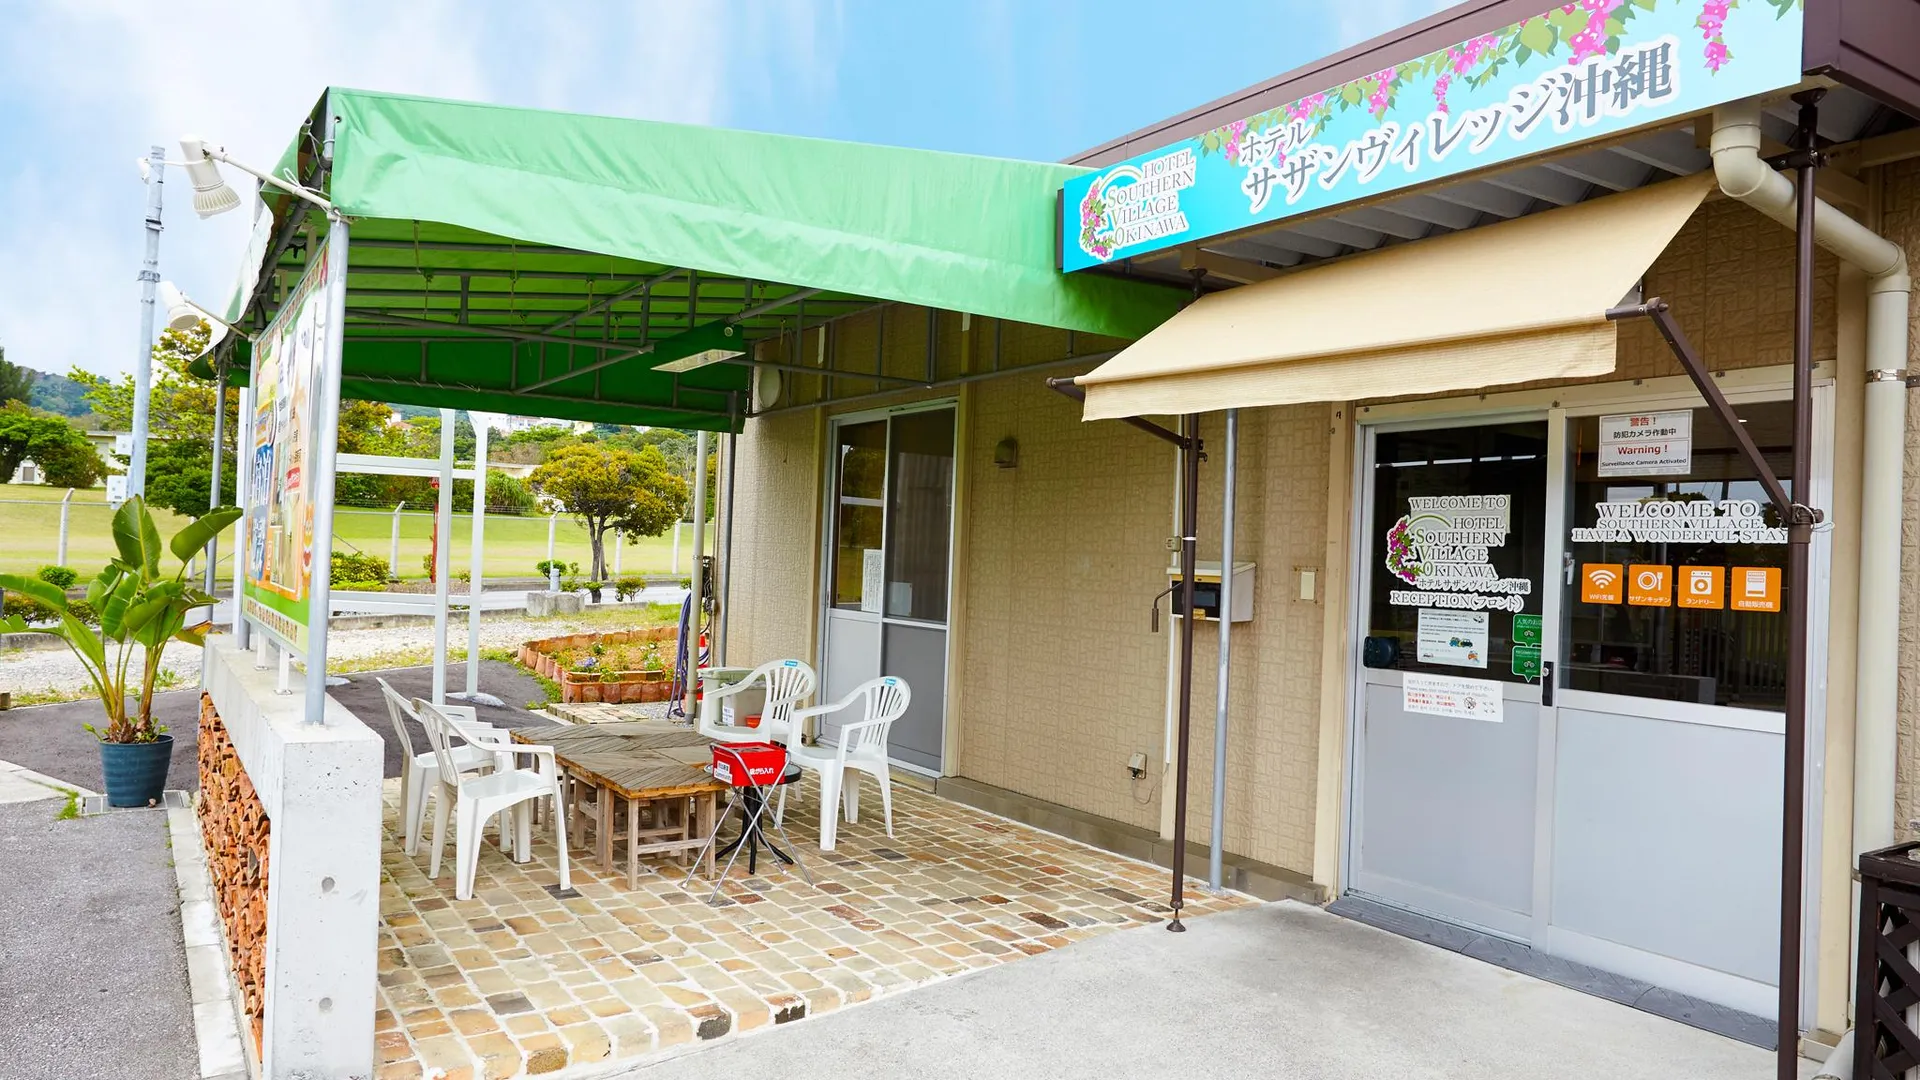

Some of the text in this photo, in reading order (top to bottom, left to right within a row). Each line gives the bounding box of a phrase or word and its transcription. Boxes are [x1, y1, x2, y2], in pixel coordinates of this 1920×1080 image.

[1245, 42, 1673, 208] サザンヴィレッジ沖縄
[1241, 121, 1311, 165] ホテル
[1143, 151, 1195, 179] HOTEL
[1108, 168, 1194, 208] SOUTHERN
[1111, 195, 1177, 225] VILLAGE
[1115, 215, 1187, 246] OKINAWA
[1613, 428, 1677, 439] 防犯カメラ作動中
[1659, 458, 1687, 466] Activated
[1410, 496, 1507, 509] WELCOME TO
[1598, 502, 1757, 518] WELCOME TO
[1453, 517, 1505, 530] HOTEL
[1598, 518, 1764, 530] SOUTHERN VILLAGE.
[1415, 528, 1504, 545] SOUTHERN
[1574, 530, 1615, 541] HAVE
[1616, 530, 1631, 541] A
[1633, 530, 1738, 541] WONDERFUL
[1420, 545, 1487, 561] VILLAGE
[1423, 561, 1497, 577] OKINAWA
[1419, 579, 1529, 592] ホテルサザンヴィレッジ沖縄
[1628, 595, 1671, 604] サザンキッチン
[1685, 598, 1716, 606] ランドリー
